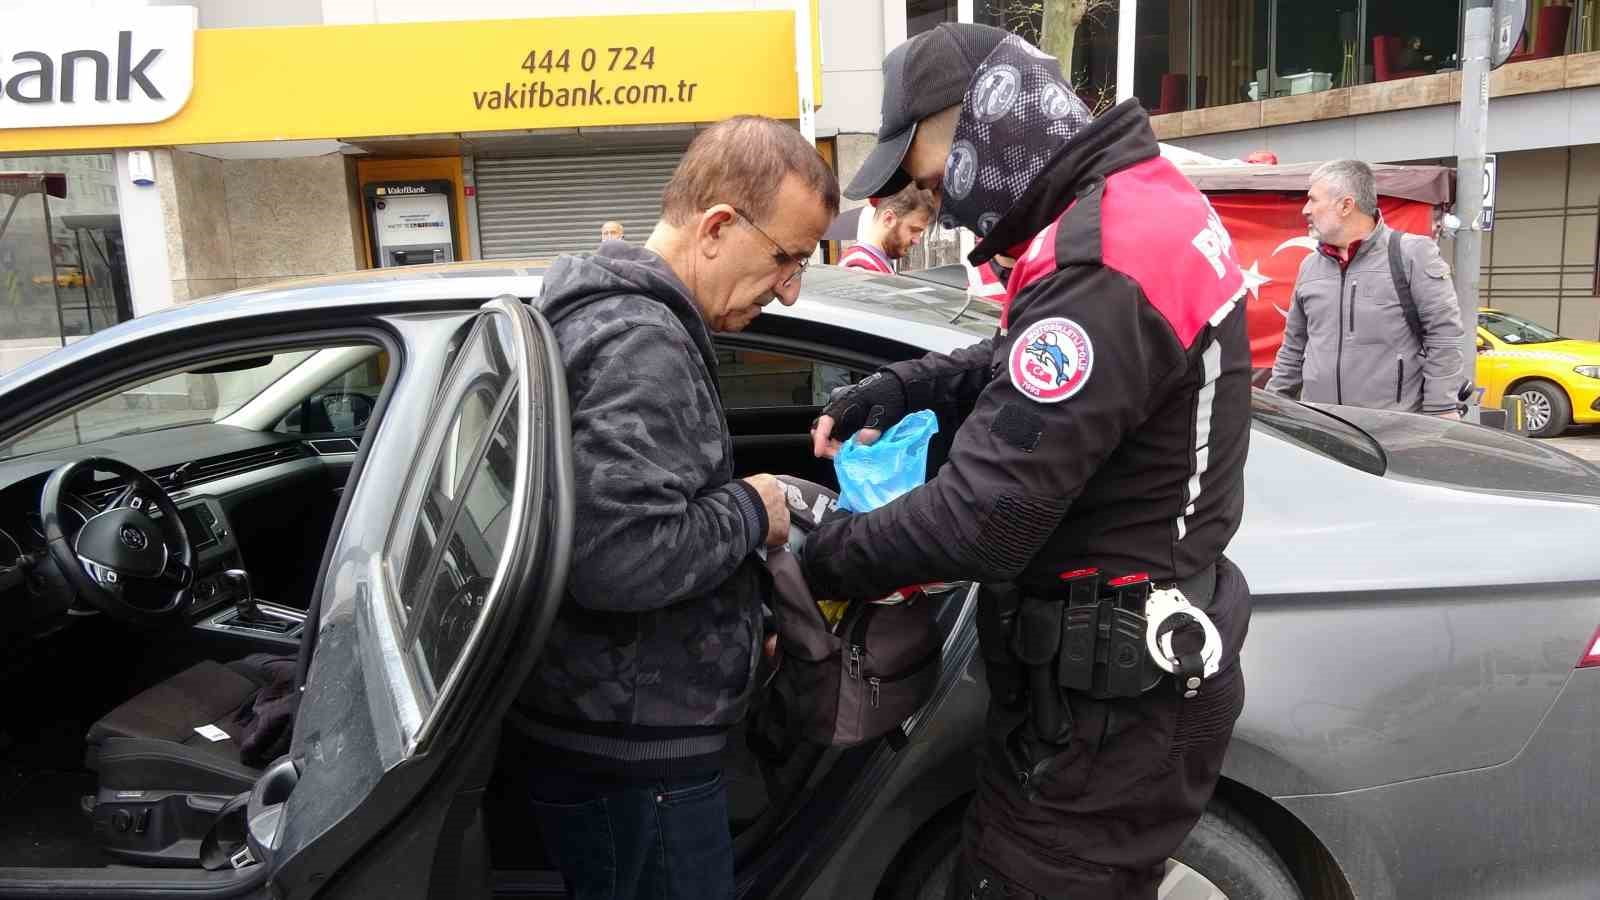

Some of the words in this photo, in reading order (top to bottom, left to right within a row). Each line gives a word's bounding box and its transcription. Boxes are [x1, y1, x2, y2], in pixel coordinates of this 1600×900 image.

[0, 30, 165, 103] ank
[521, 49, 571, 74] 444
[580, 48, 597, 72] 0
[607, 46, 656, 71] 724
[472, 80, 698, 110] vakifbank.com.tr
